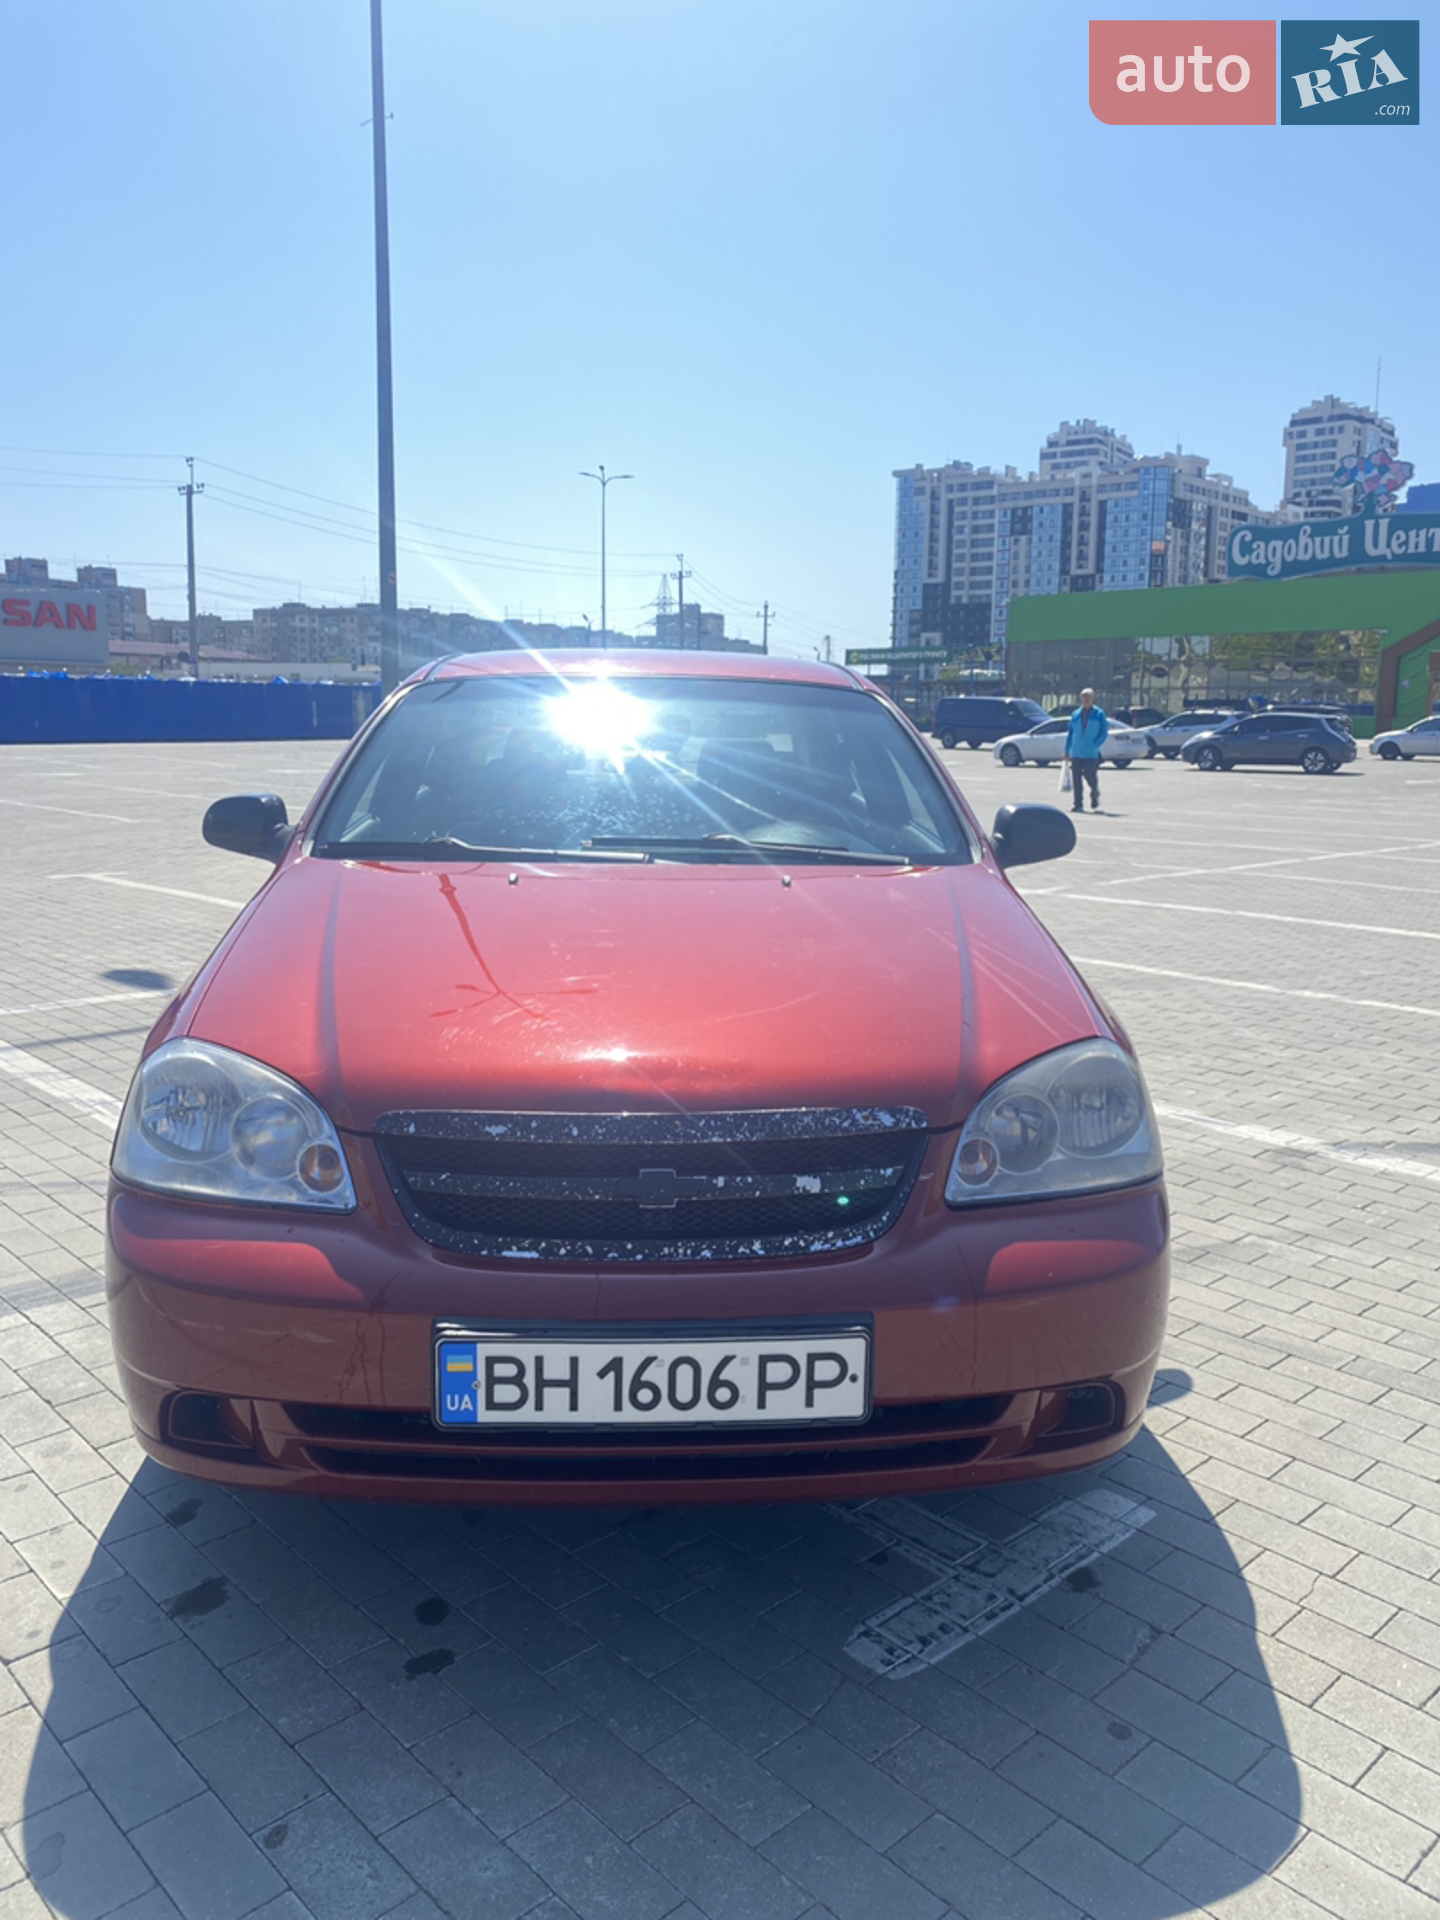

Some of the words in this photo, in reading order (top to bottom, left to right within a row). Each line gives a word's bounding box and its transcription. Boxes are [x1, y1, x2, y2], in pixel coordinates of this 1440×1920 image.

[1232, 525, 1350, 576] Садовий
[2, 597, 97, 631] SAN
[446, 1394, 474, 1411] UA
[484, 1355, 579, 1412] BH
[596, 1355, 741, 1412] 1606
[757, 1352, 849, 1410] PP
